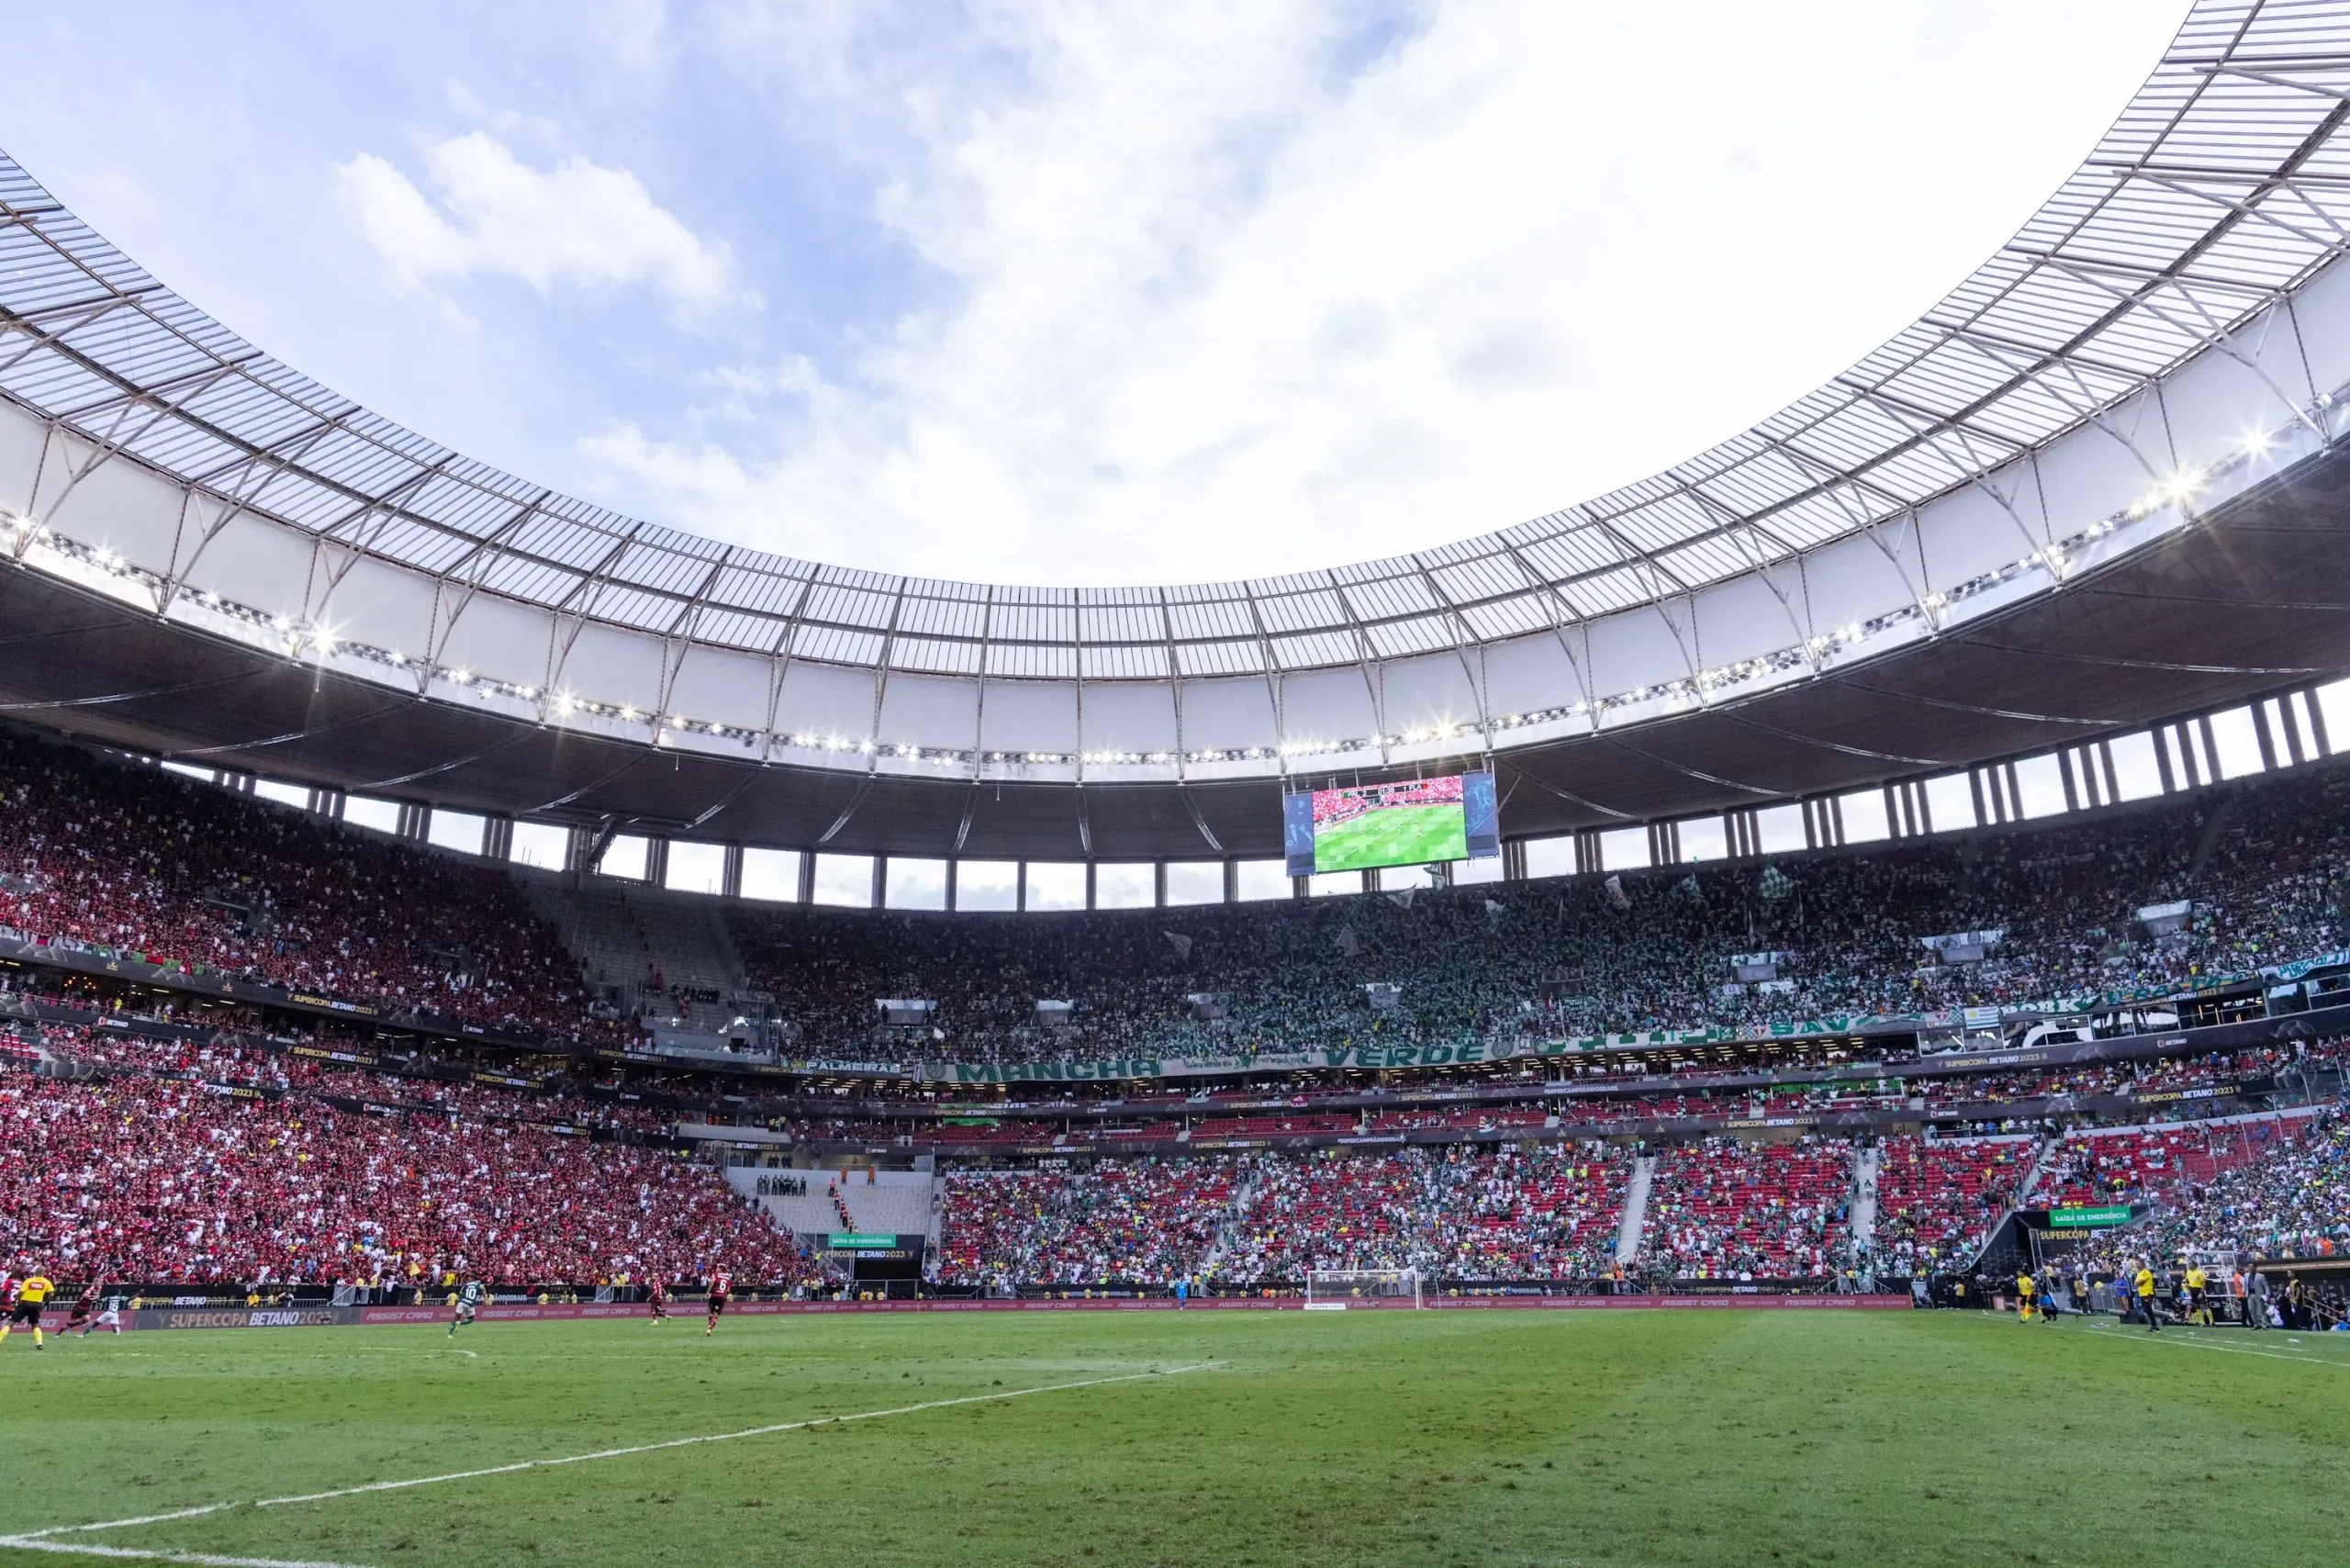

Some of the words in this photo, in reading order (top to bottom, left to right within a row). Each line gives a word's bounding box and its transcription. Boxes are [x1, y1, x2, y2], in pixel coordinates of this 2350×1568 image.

[2198, 988, 2217, 997] 2023
[293, 994, 330, 1008] SUPERCOPA
[330, 1001, 356, 1012] BETANO
[356, 1005, 372, 1014] 2023
[106, 1019, 129, 1028] BETANO
[2165, 1038, 2187, 1047] BETANO
[293, 1047, 330, 1058] SUPERCOPA
[330, 1051, 356, 1062] BETANO
[356, 1056, 373, 1065] 2023
[626, 1053, 648, 1061] BETANO
[1944, 1058, 1988, 1068] SUPERCOPA
[1988, 1057, 2020, 1065] BETANO
[2020, 1054, 2040, 1062] 2023
[806, 1060, 900, 1073] PALMEIRAS
[956, 1060, 1160, 1081] MANCHA
[1325, 1044, 1484, 1067] VERDE
[476, 1073, 505, 1085] SUPERCOPA
[505, 1078, 526, 1087] BETANO
[525, 1081, 540, 1089] 2023
[233, 1087, 253, 1098] 2023
[2139, 1092, 2183, 1103] SUPERCOPA
[2183, 1089, 2213, 1099] BETANO
[2212, 1087, 2234, 1096] 2023
[1766, 1118, 1794, 1126] BETANO
[1794, 1117, 1814, 1126] 2023
[553, 1126, 573, 1135] BETANO
[2087, 1212, 2127, 1221] EMERGÊNCIA
[2040, 1230, 2089, 1239] SUPERCOPA
[719, 1279, 728, 1292] 6
[465, 1287, 477, 1300] 10
[174, 1296, 206, 1305] BETANO
[170, 1313, 248, 1328] SUPERCOPA
[249, 1311, 299, 1326] BETANO
[298, 1311, 333, 1324] 2023
[406, 1311, 433, 1320] CARD
